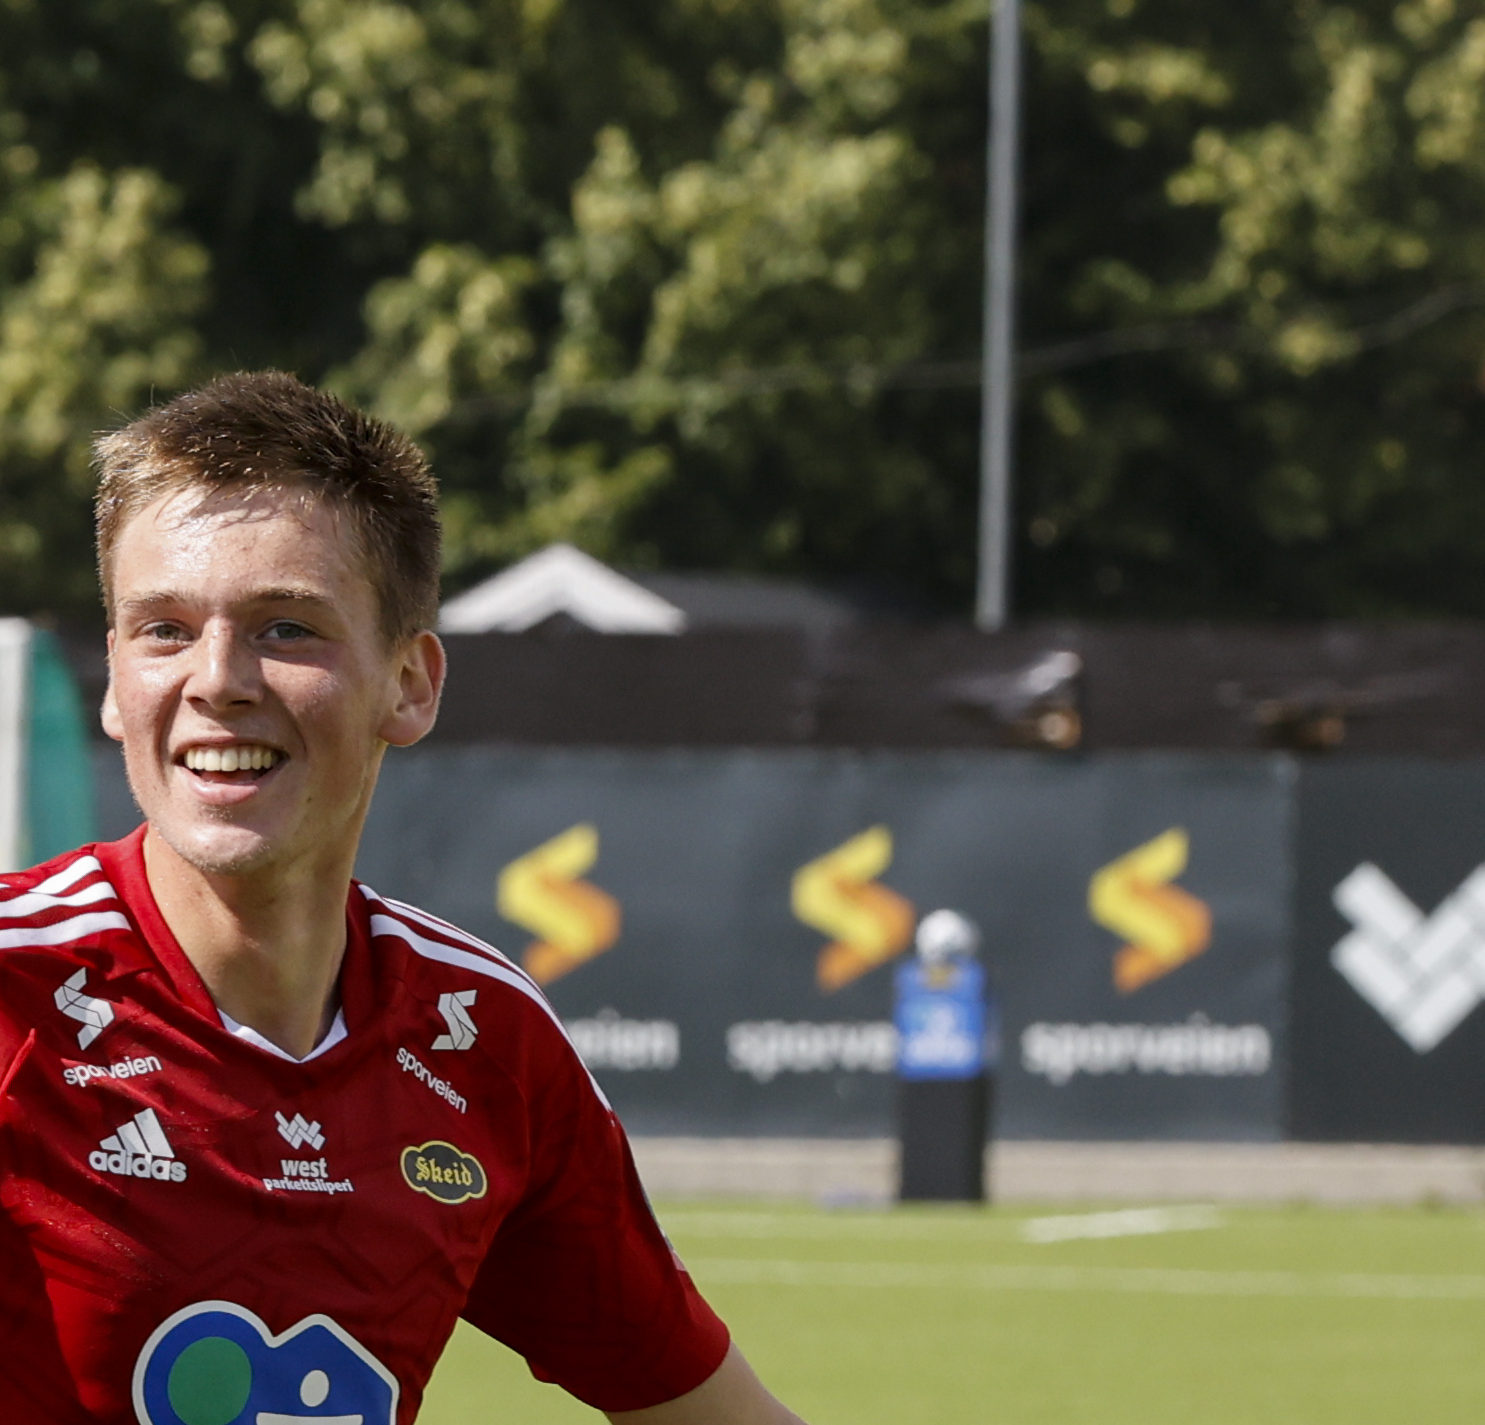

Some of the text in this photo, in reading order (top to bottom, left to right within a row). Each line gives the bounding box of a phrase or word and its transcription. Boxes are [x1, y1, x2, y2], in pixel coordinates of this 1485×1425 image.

[1021, 1011, 1272, 1088] sporveien
[63, 1056, 163, 1088] sporveien
[396, 1047, 468, 1114] sporveien
[89, 1148, 188, 1183] adidas
[281, 1157, 328, 1178] west
[415, 1156, 474, 1187] Skeid
[263, 1177, 354, 1195] parkettsliperi
